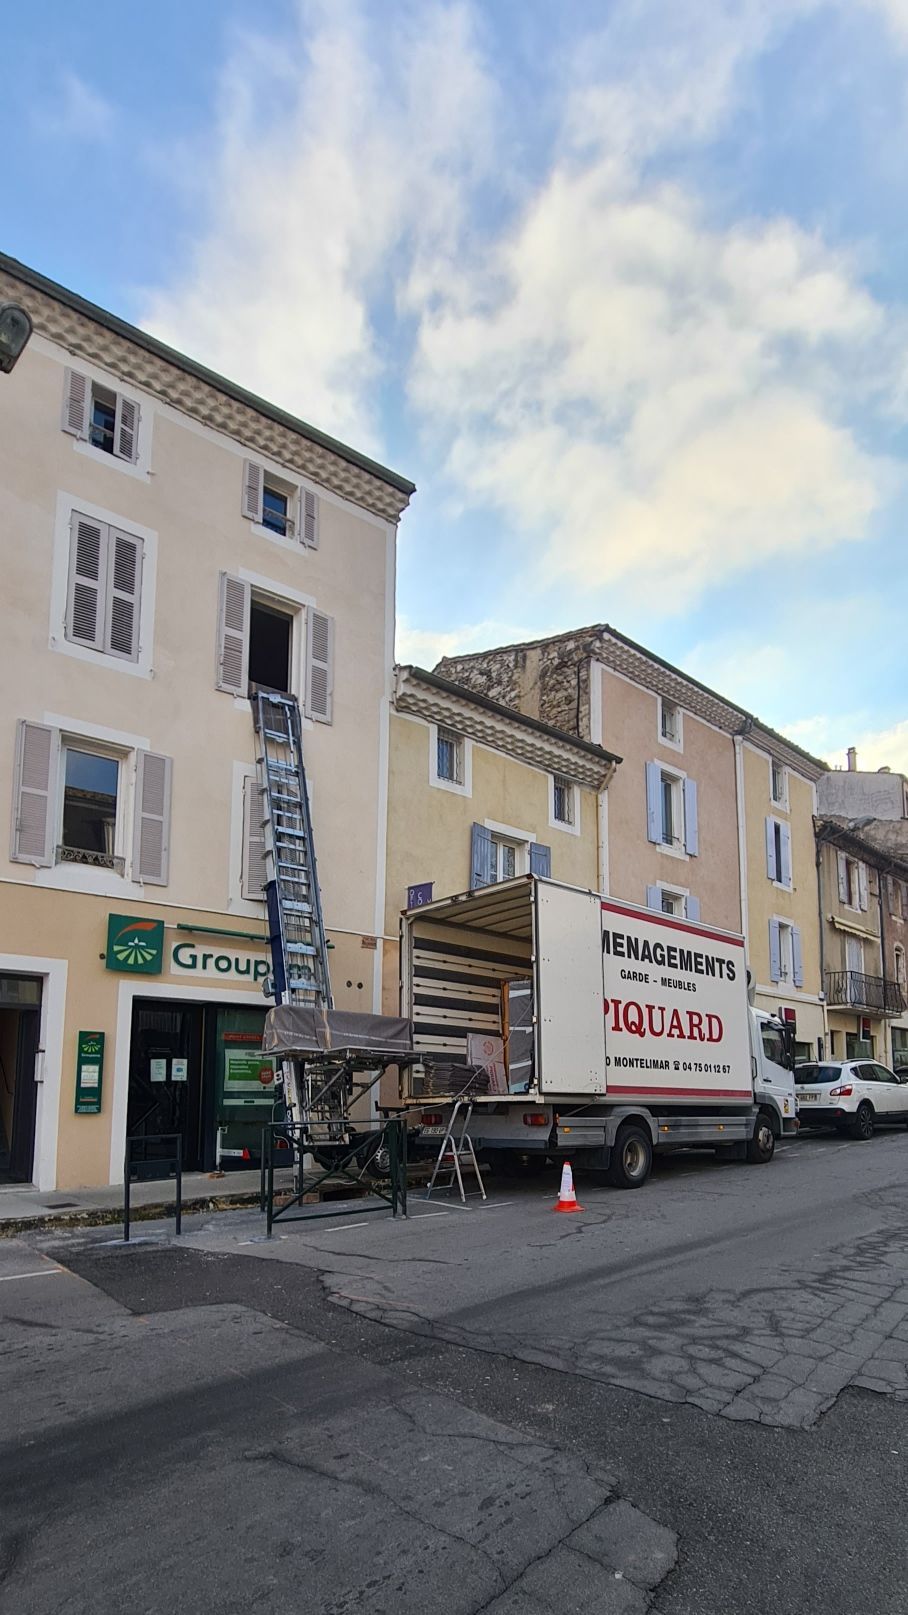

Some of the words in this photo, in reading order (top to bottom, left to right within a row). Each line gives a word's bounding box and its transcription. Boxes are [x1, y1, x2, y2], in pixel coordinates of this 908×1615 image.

[620, 969, 650, 984] GARDE
[660, 977, 697, 992] MEUBLES
[614, 1056, 670, 1070] MONTELIMAR
[682, 1062, 692, 1072] 04
[694, 1063, 702, 1072] 75
[704, 1063, 712, 1073] 01
[713, 1064, 721, 1073] 12
[722, 1065, 731, 1074] 67
